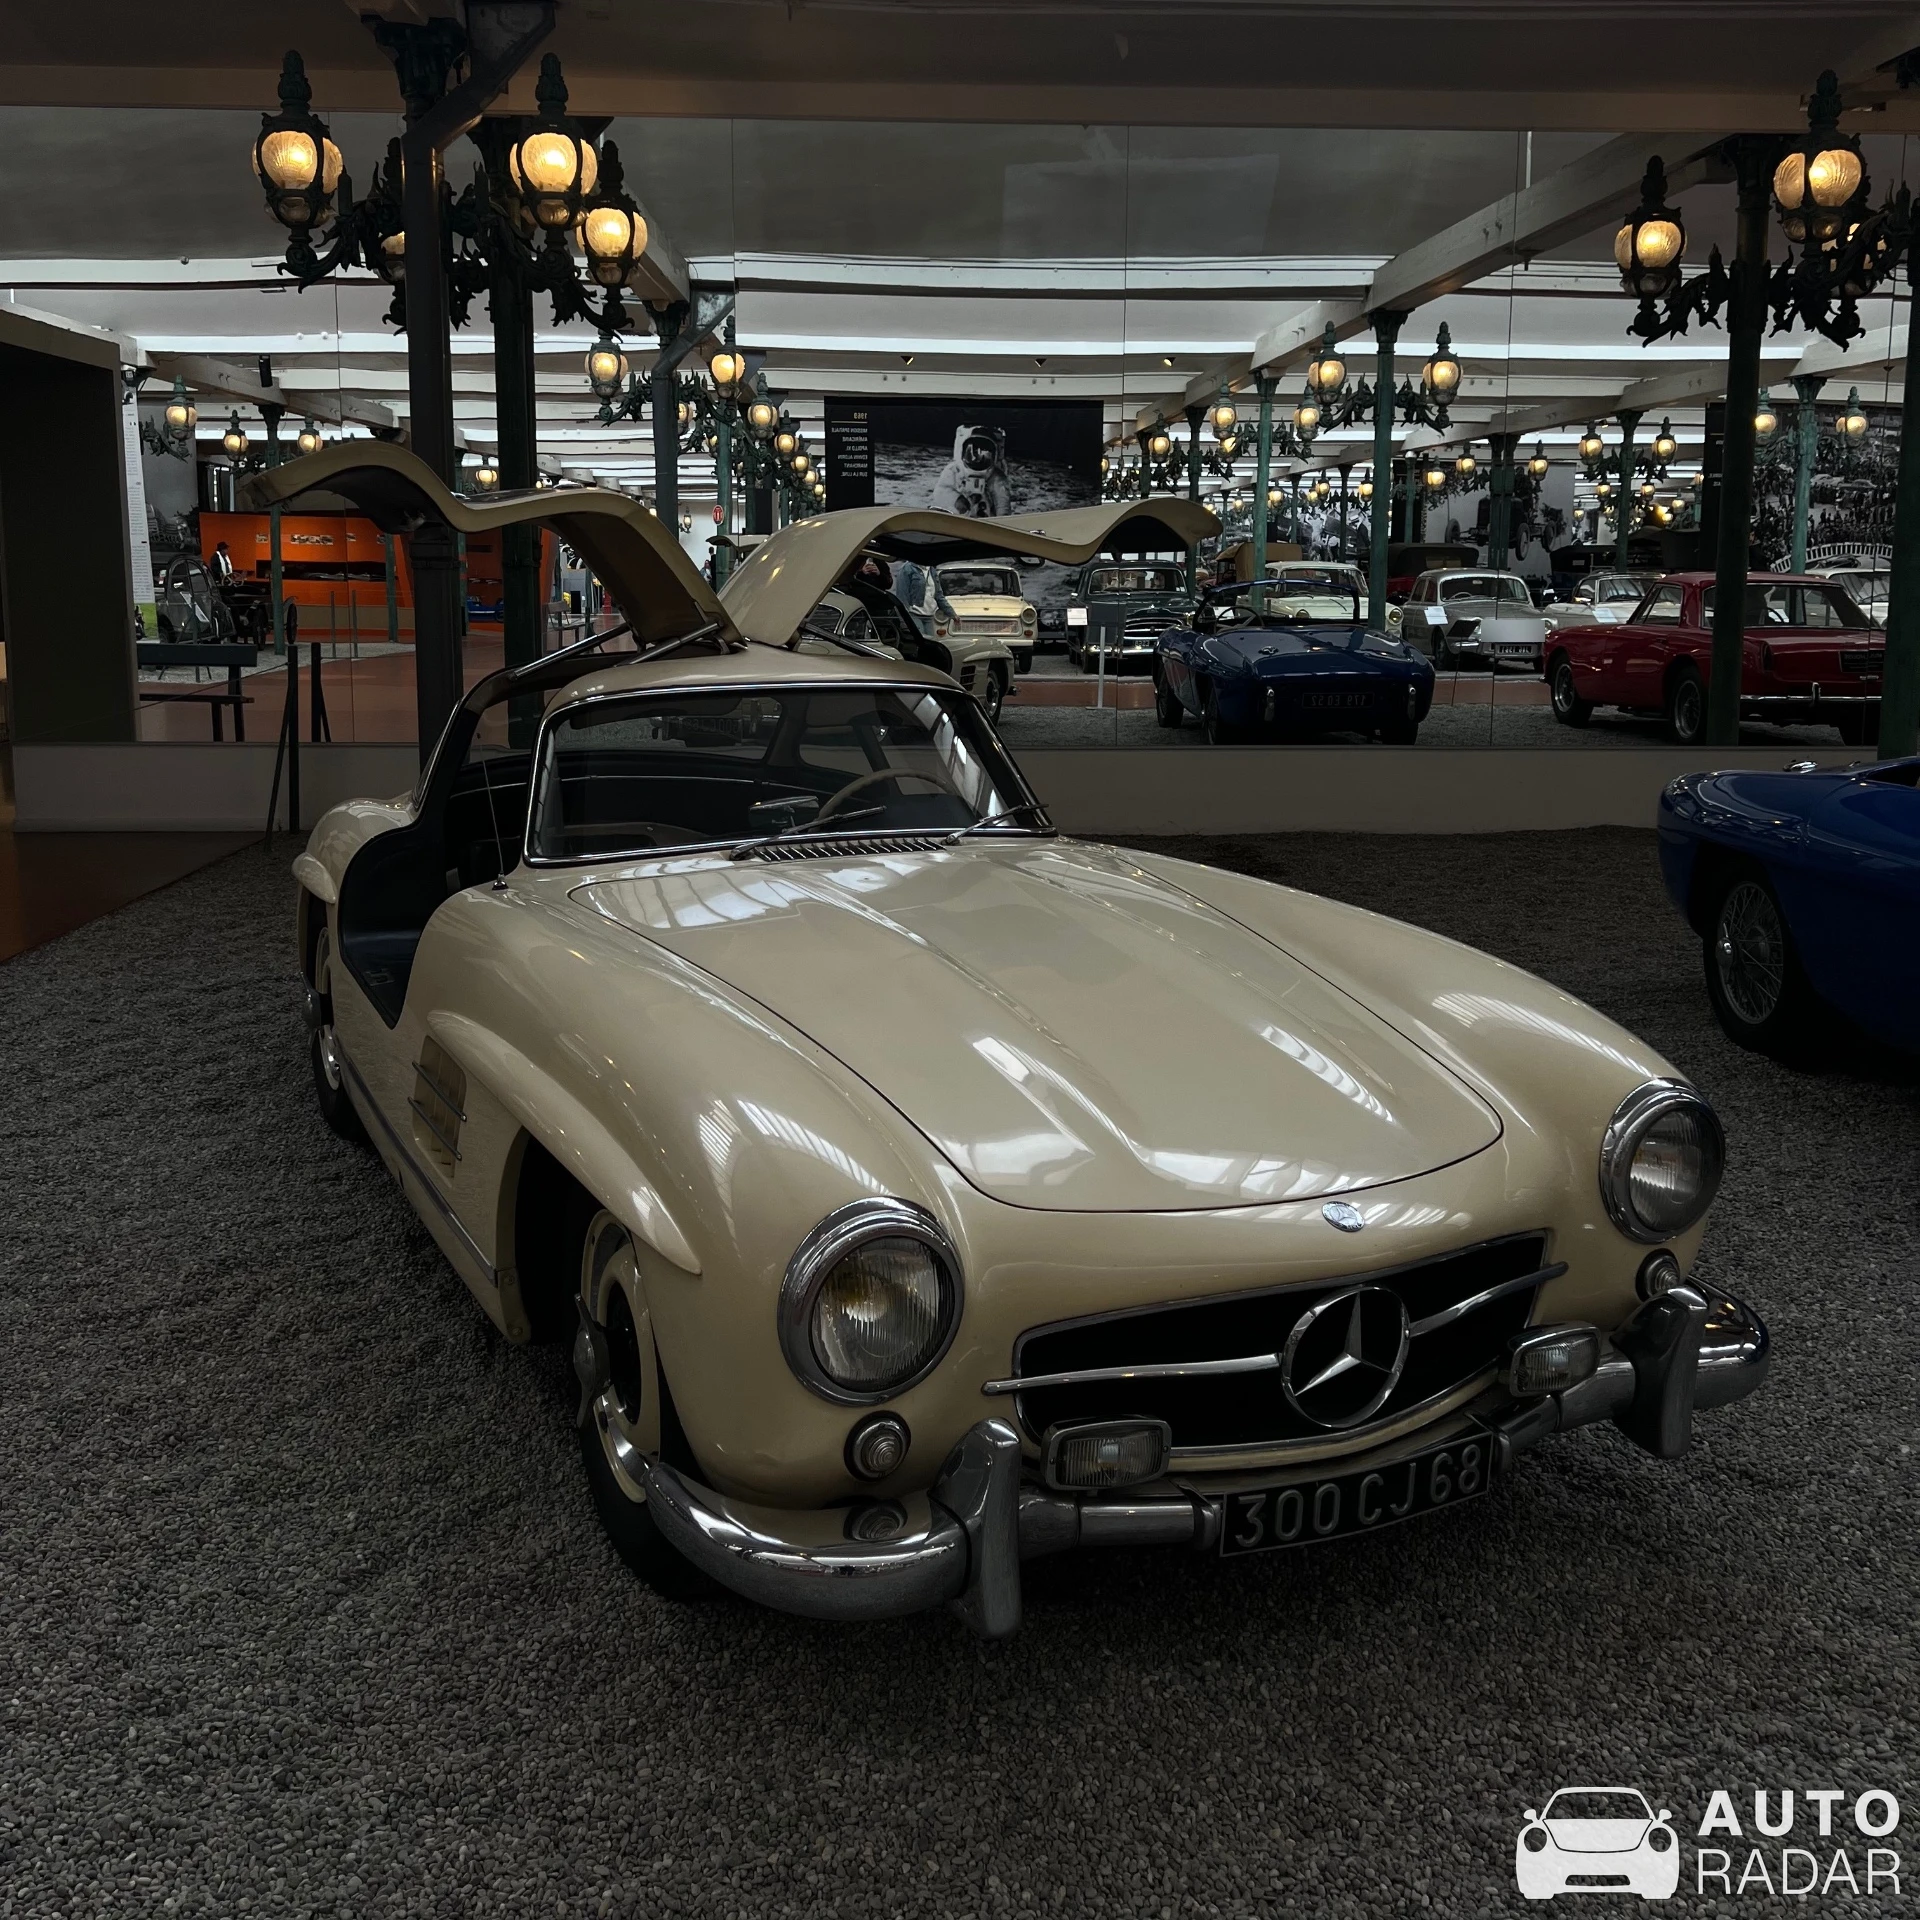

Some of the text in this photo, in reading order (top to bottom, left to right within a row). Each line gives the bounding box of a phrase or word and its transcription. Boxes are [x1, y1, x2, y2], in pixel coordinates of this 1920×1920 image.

[1234, 1443, 1482, 1548] 300 CJ 68
